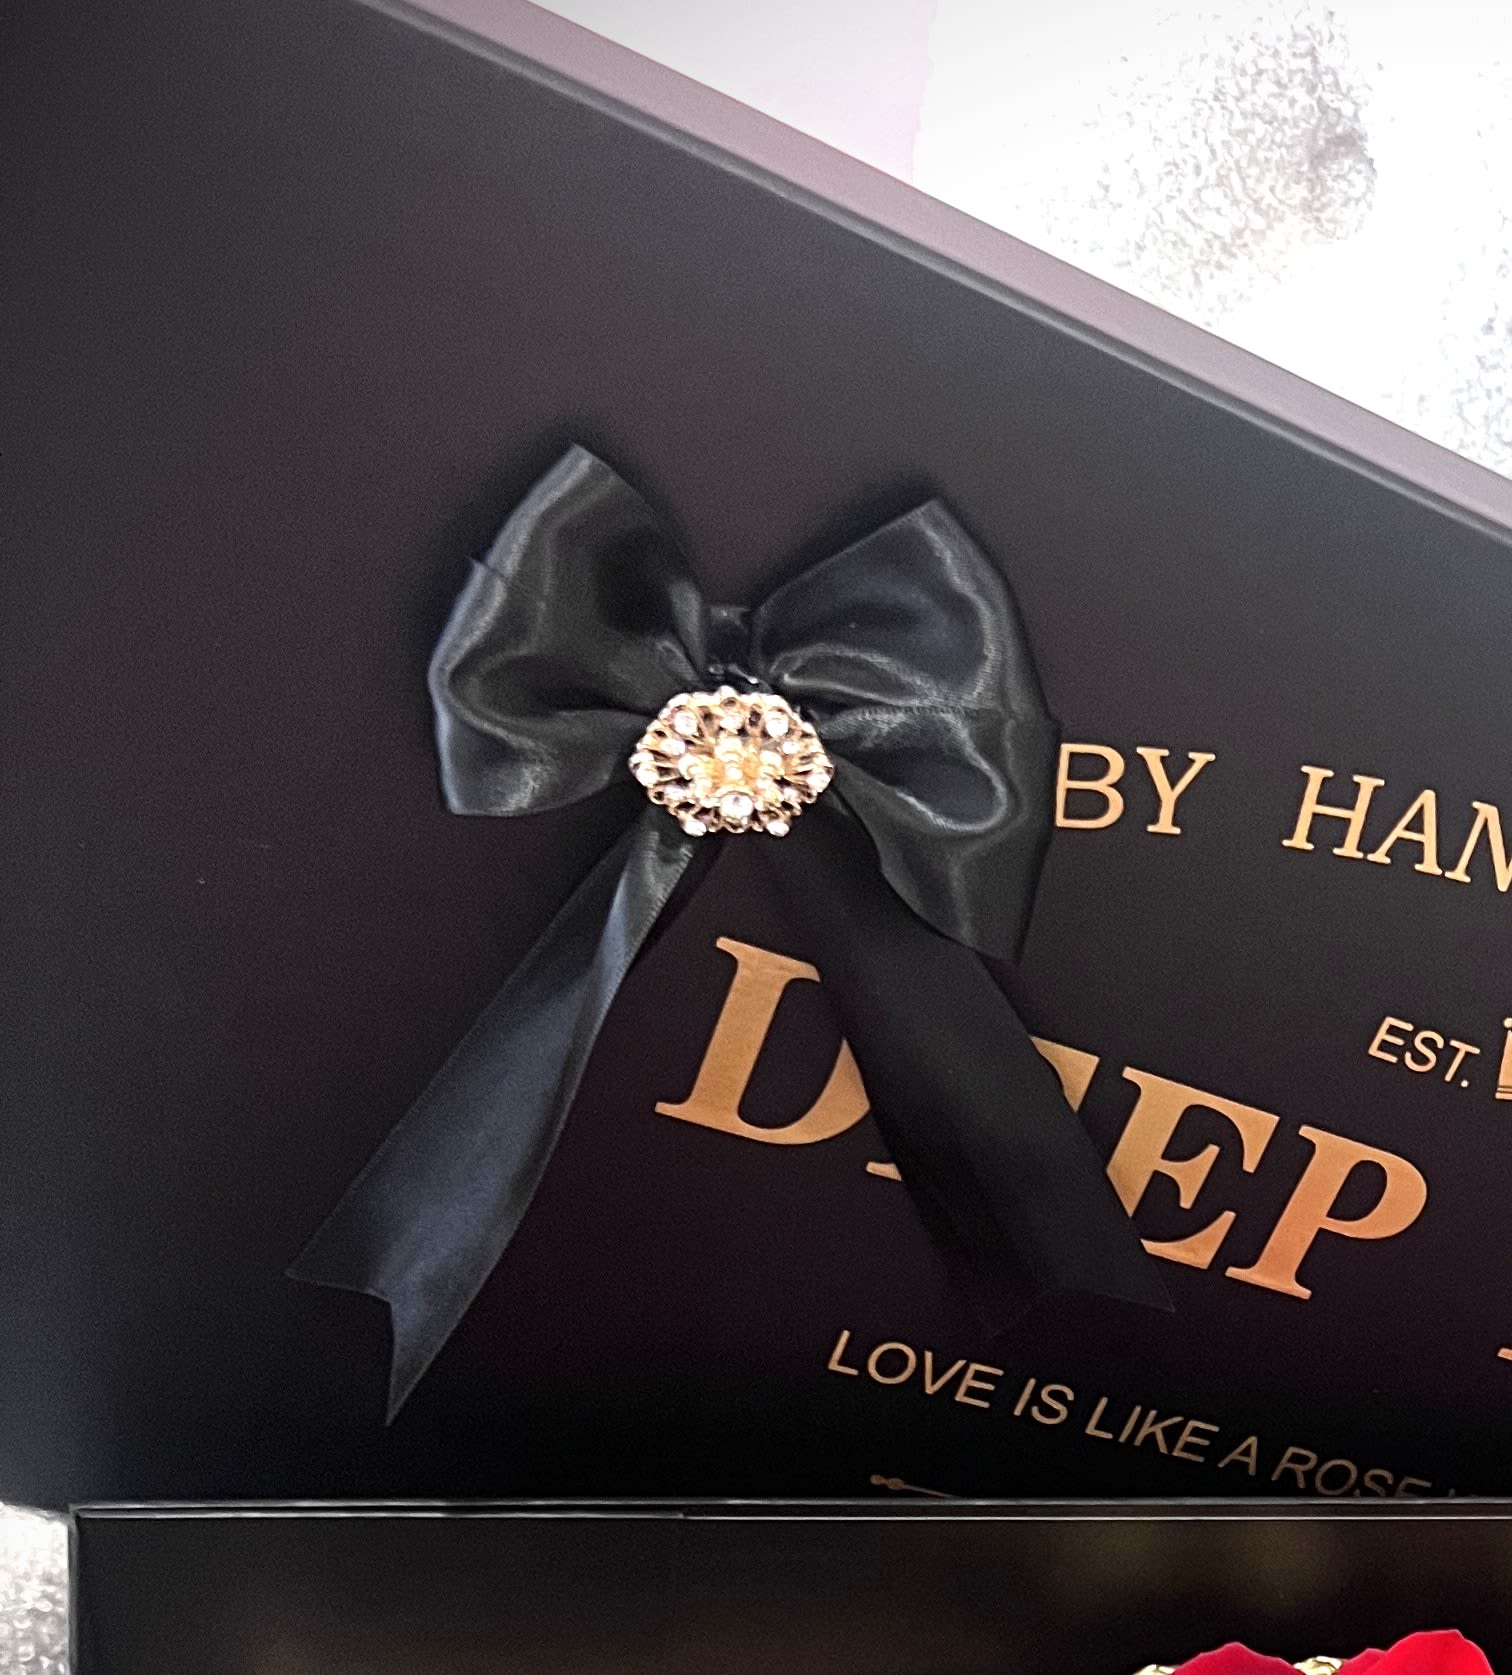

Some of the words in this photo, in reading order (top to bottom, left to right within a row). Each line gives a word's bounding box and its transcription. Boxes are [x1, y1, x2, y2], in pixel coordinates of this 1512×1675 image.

[1054, 742, 1216, 836] BY
[1367, 1016, 1481, 1088] EST.
[654, 936, 1429, 1301] DEP
[827, 1329, 1006, 1408] LOVE
[1012, 1377, 1077, 1425] IS
[1084, 1396, 1220, 1464] LIKE
[1217, 1435, 1258, 1476] A
